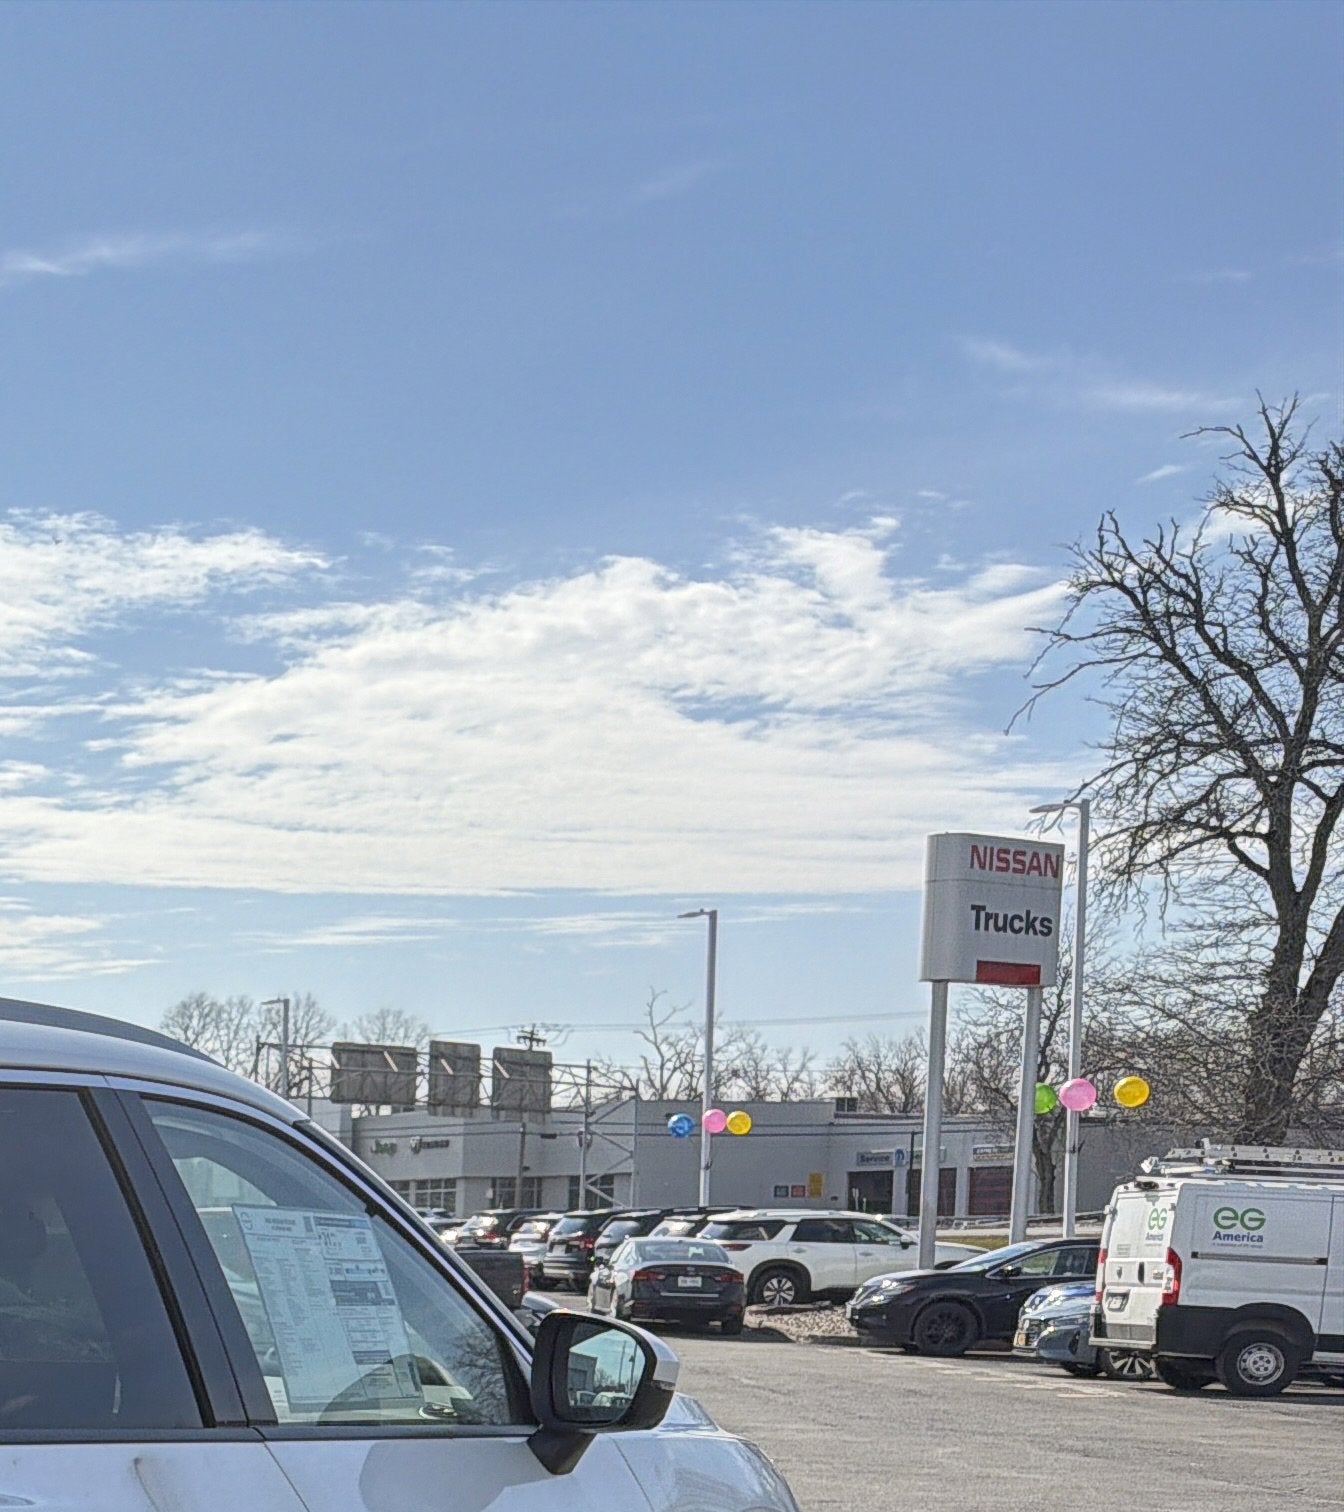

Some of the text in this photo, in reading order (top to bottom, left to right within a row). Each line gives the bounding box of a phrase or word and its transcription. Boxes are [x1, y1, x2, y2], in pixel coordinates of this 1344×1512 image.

[969, 844, 1060, 879] NISSAN
[970, 903, 1053, 937] Trucks
[1212, 1230, 1264, 1243] America
